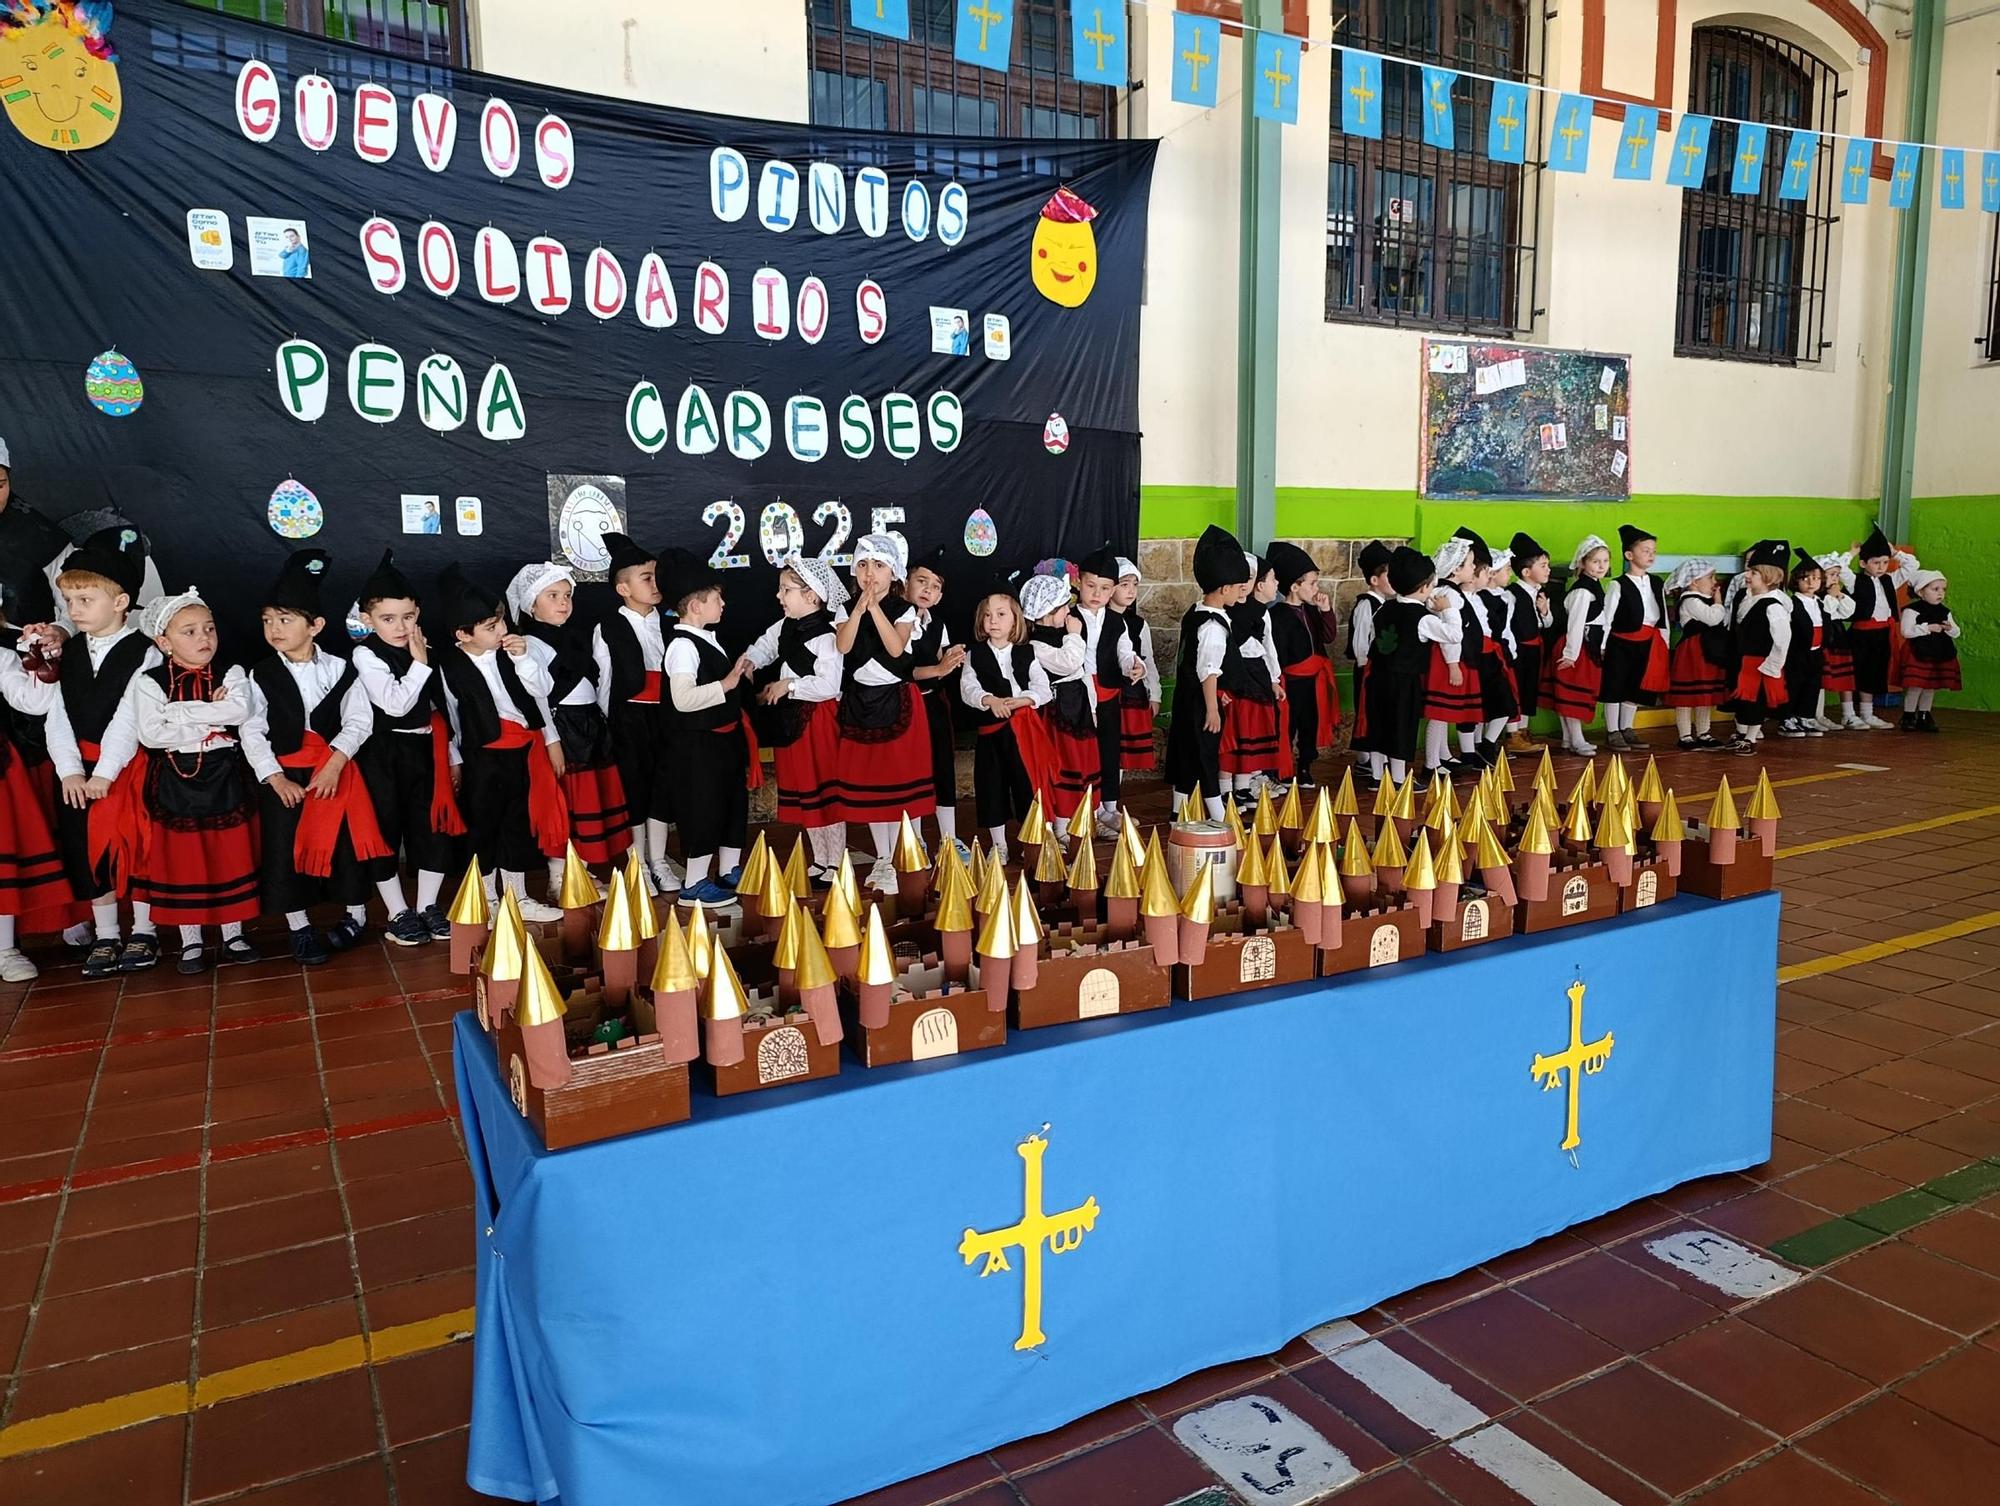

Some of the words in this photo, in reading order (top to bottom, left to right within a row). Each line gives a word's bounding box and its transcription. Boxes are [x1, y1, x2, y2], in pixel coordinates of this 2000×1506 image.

[242, 67, 569, 184] GÜEVOS
[718, 154, 964, 241] PINTOS
[364, 222, 883, 341] SOLIDARIOS
[282, 344, 524, 432] PEÑA
[630, 386, 958, 458] CARESES
[702, 501, 909, 569] 2025
